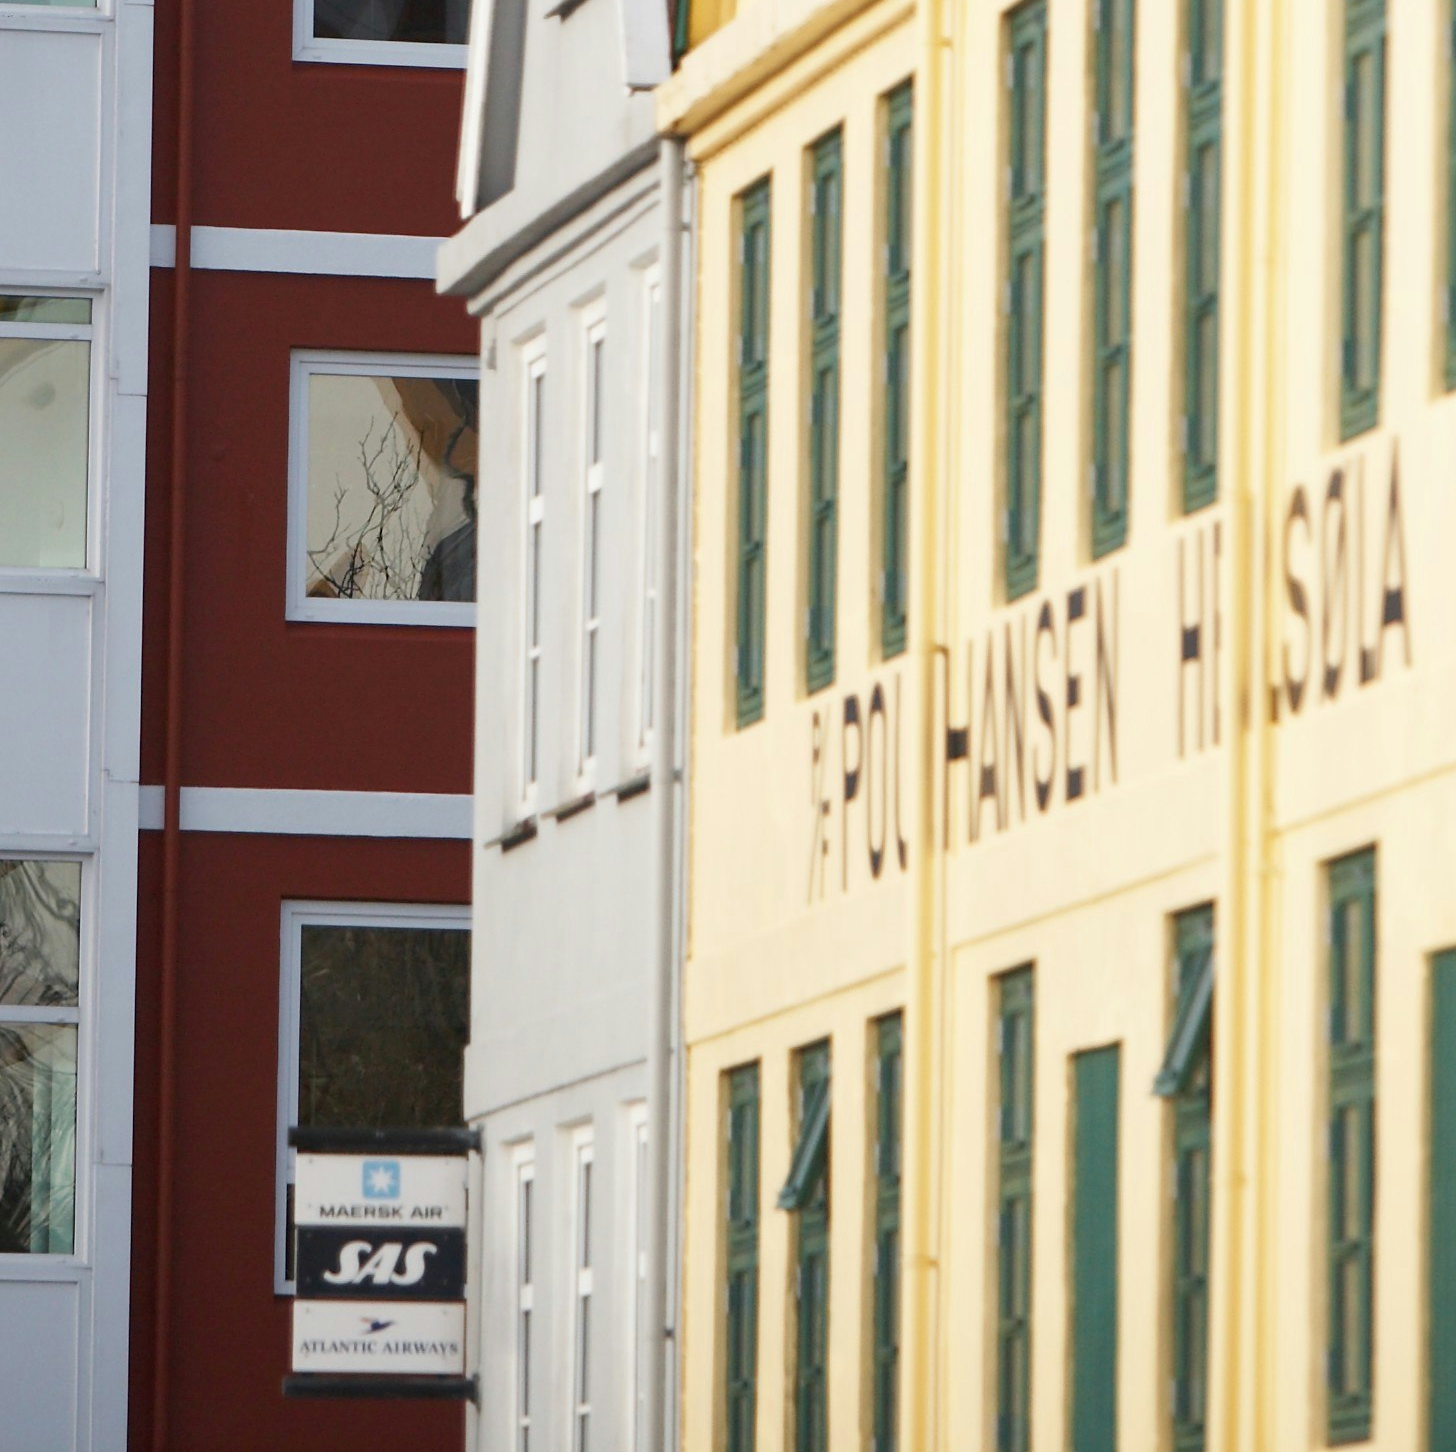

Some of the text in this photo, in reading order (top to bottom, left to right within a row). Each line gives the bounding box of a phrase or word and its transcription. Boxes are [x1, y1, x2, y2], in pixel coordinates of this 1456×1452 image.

[943, 566, 1119, 852] HANSEN
[319, 1204, 443, 1219] MAERSK AIR
[323, 1240, 438, 1286] SAS
[300, 1340, 459, 1356] ATLANTIC AIRWAYS
